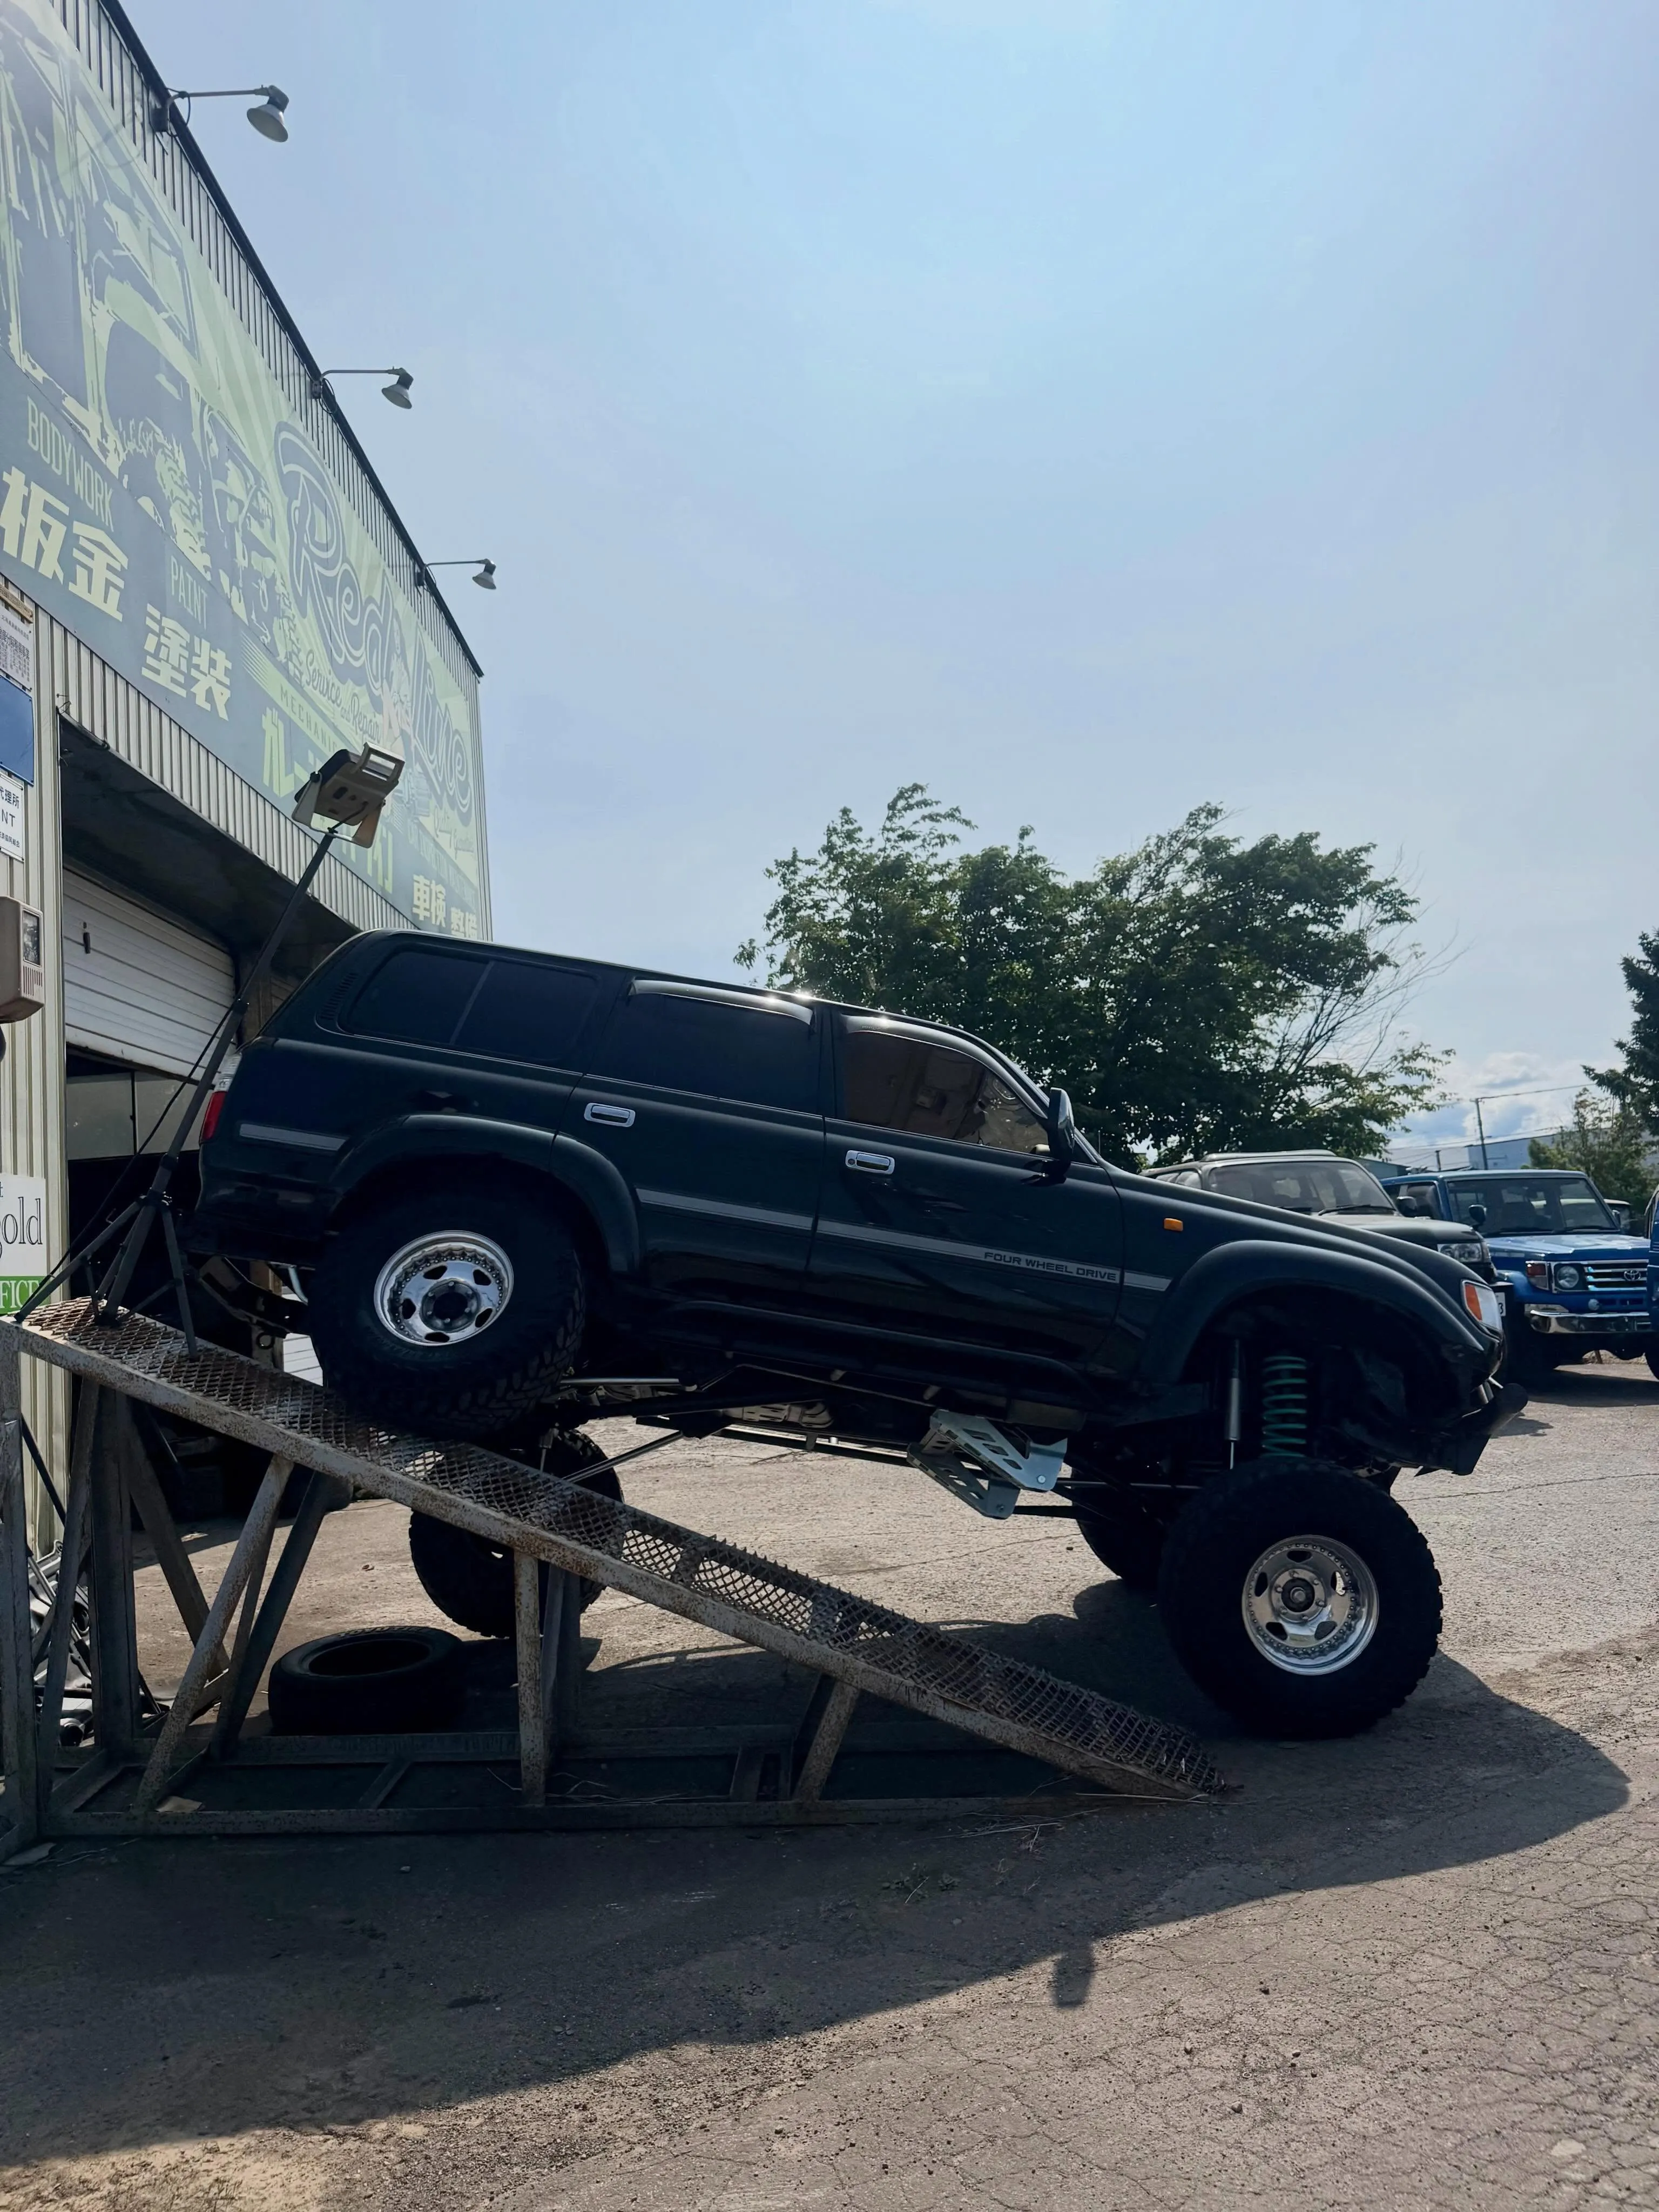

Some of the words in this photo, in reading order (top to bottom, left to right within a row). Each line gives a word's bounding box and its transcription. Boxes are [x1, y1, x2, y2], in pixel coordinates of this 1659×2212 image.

[27, 395, 115, 531] BODYWORK
[0, 466, 129, 622] 板金
[171, 556, 207, 630] PAINT
[274, 422, 395, 704] Red
[409, 621, 473, 813] Line
[141, 603, 233, 721] 塗装
[351, 692, 381, 745] Repair
[412, 874, 446, 928] 車検
[0, 1196, 43, 1258] old
[984, 1252, 1021, 1265] FOUR
[1024, 1258, 1073, 1274] WHEEL
[1076, 1267, 1116, 1281] DRIVE
